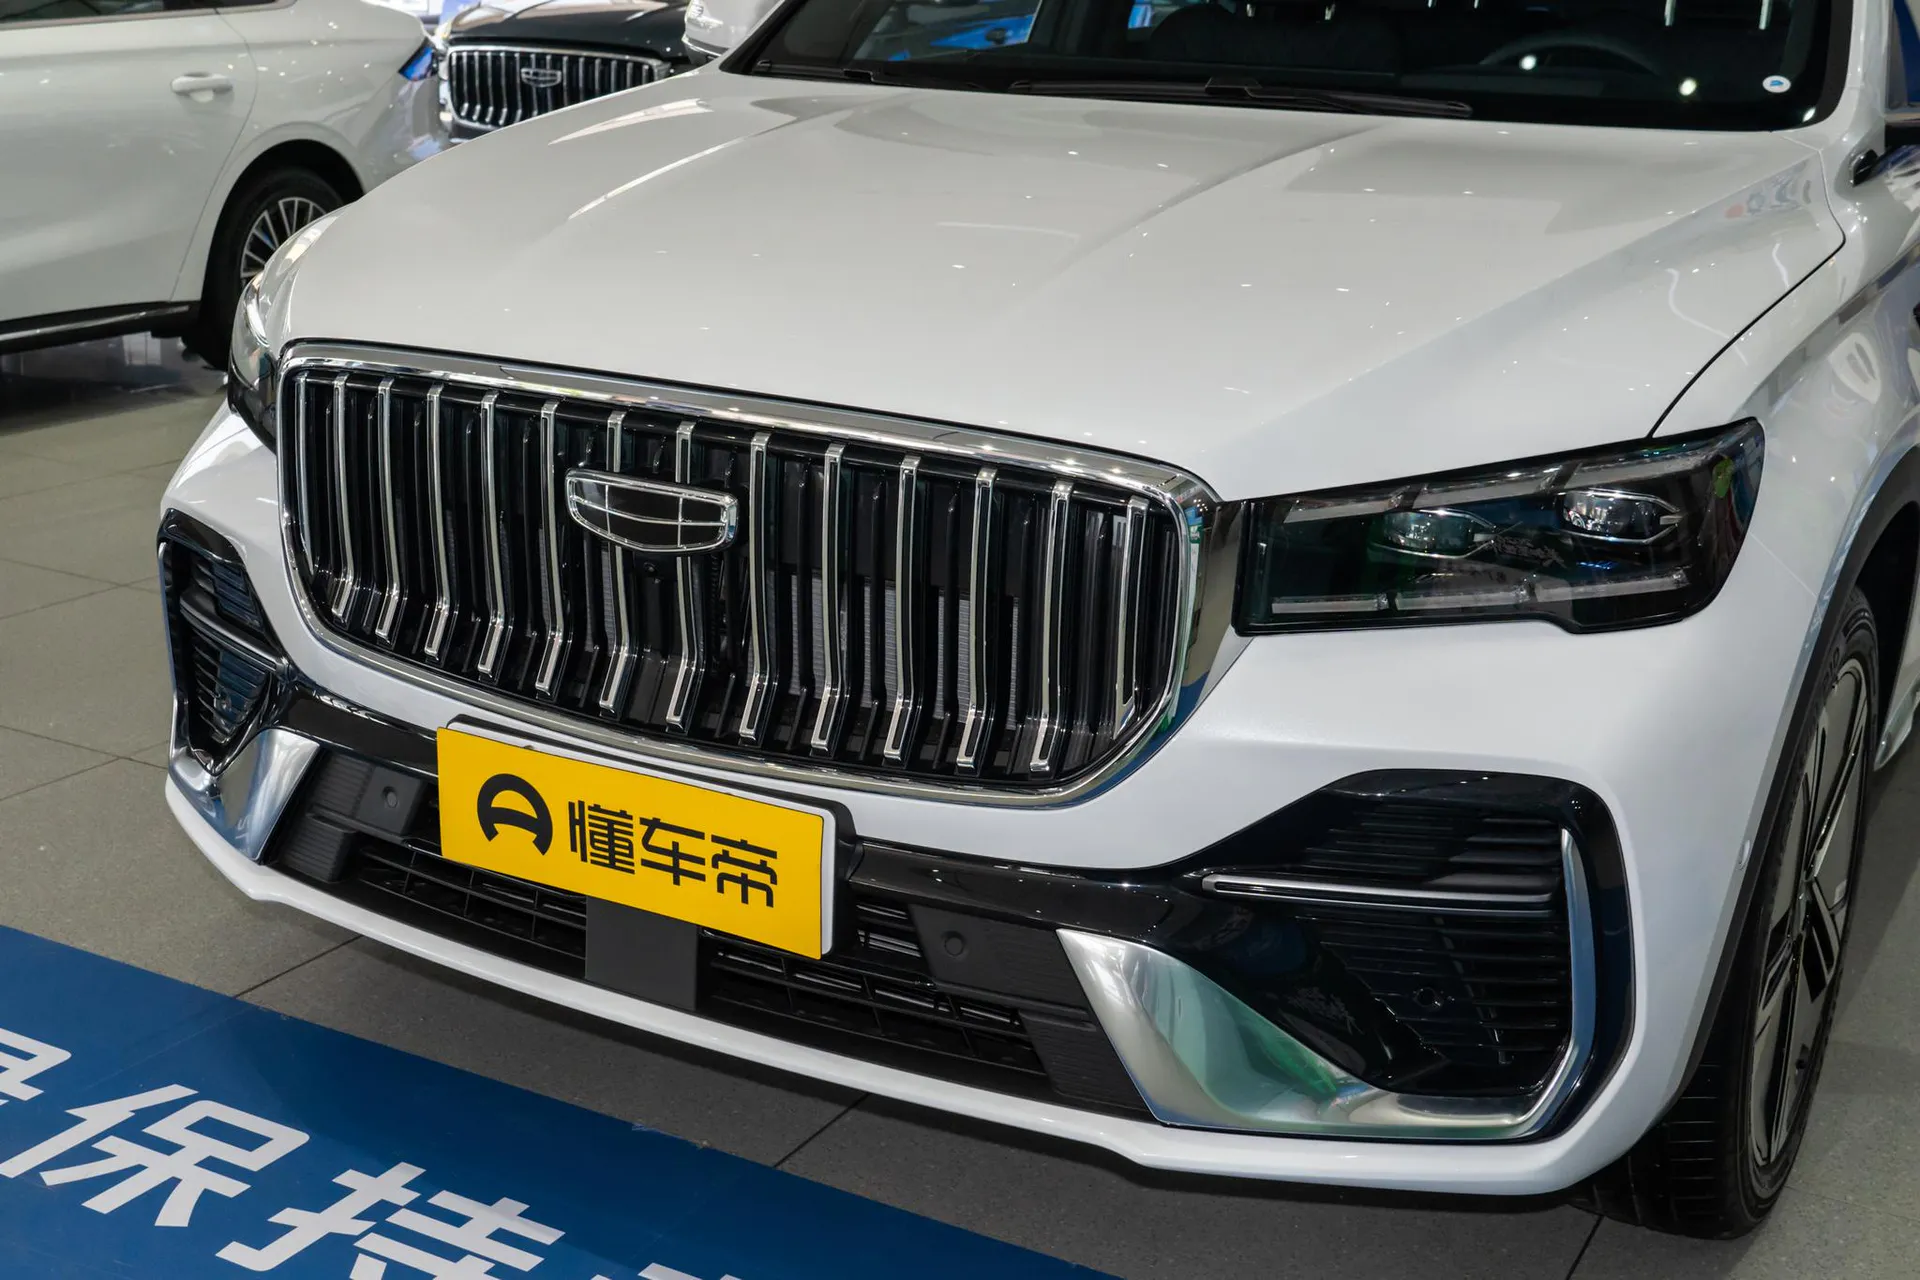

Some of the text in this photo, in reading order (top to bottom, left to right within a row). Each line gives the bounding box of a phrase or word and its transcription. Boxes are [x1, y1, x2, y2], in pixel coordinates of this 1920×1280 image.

[568, 800, 778, 908] 懂车帝
[0, 1028, 738, 1280] 保持
